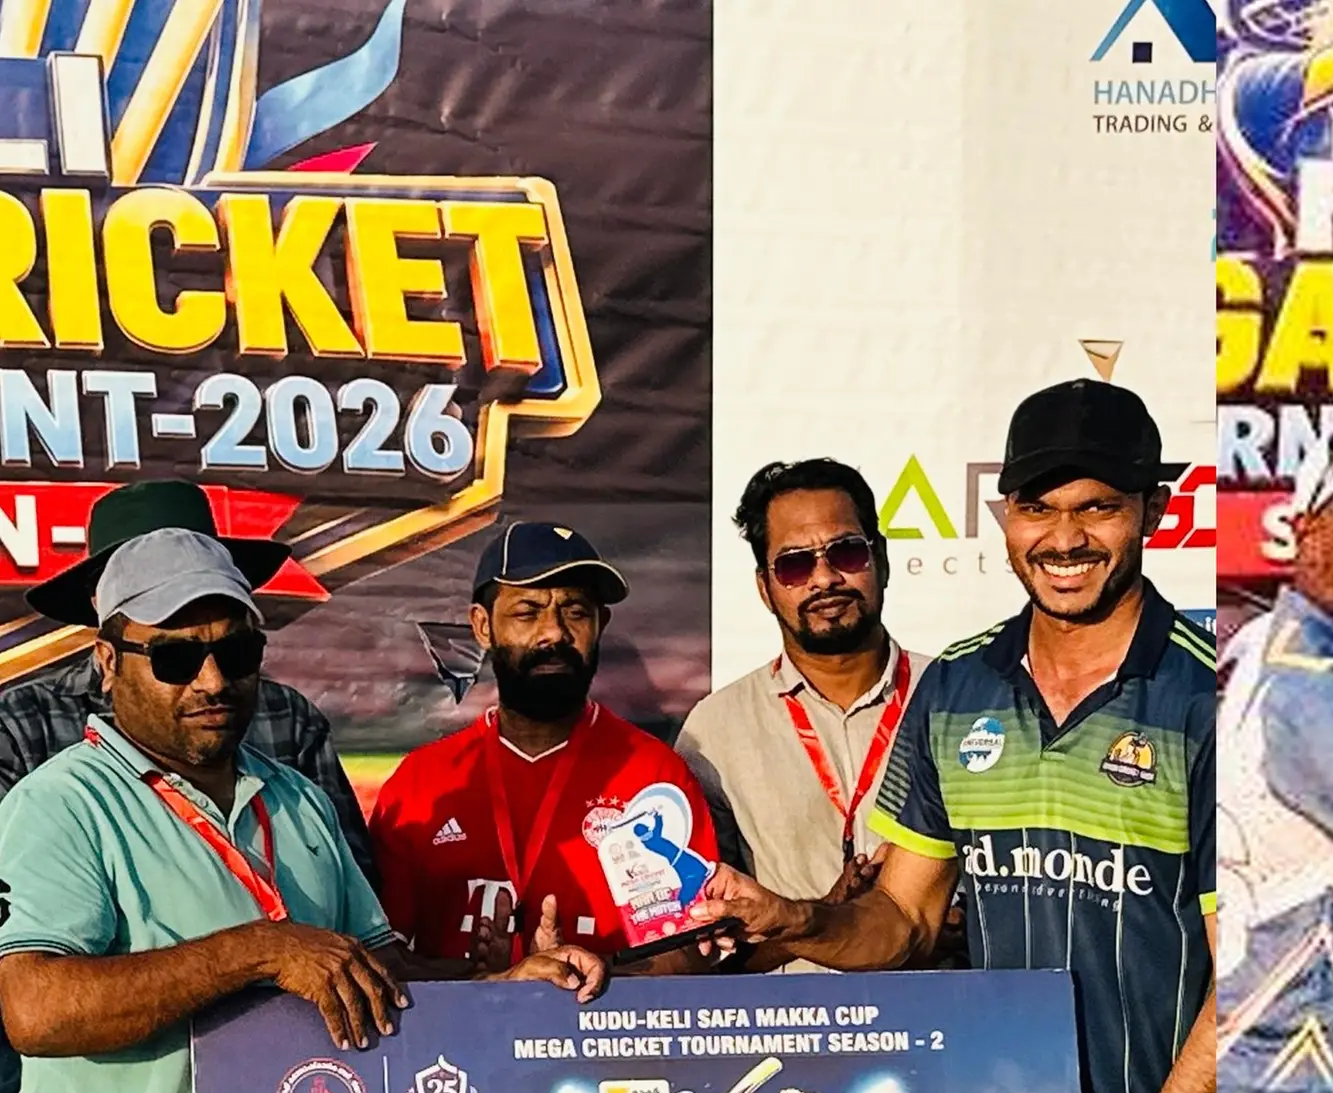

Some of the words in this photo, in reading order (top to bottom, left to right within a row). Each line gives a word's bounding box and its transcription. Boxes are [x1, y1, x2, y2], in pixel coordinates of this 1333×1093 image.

[1093, 114, 1187, 133] TRADING
[1198, 114, 1213, 133] &
[962, 834, 1153, 896] ad.monde
[579, 1009, 691, 1031] KUDU-KELI
[696, 1007, 750, 1028] SAFA
[755, 1006, 831, 1028] MAKKA
[835, 1005, 879, 1026] CUP
[514, 1037, 577, 1059] MEGA
[581, 1037, 673, 1058] CRICKET
[678, 1034, 823, 1056] TOURNAMENT
[828, 1032, 910, 1053] SEASON
[930, 1031, 944, 1051] 2
